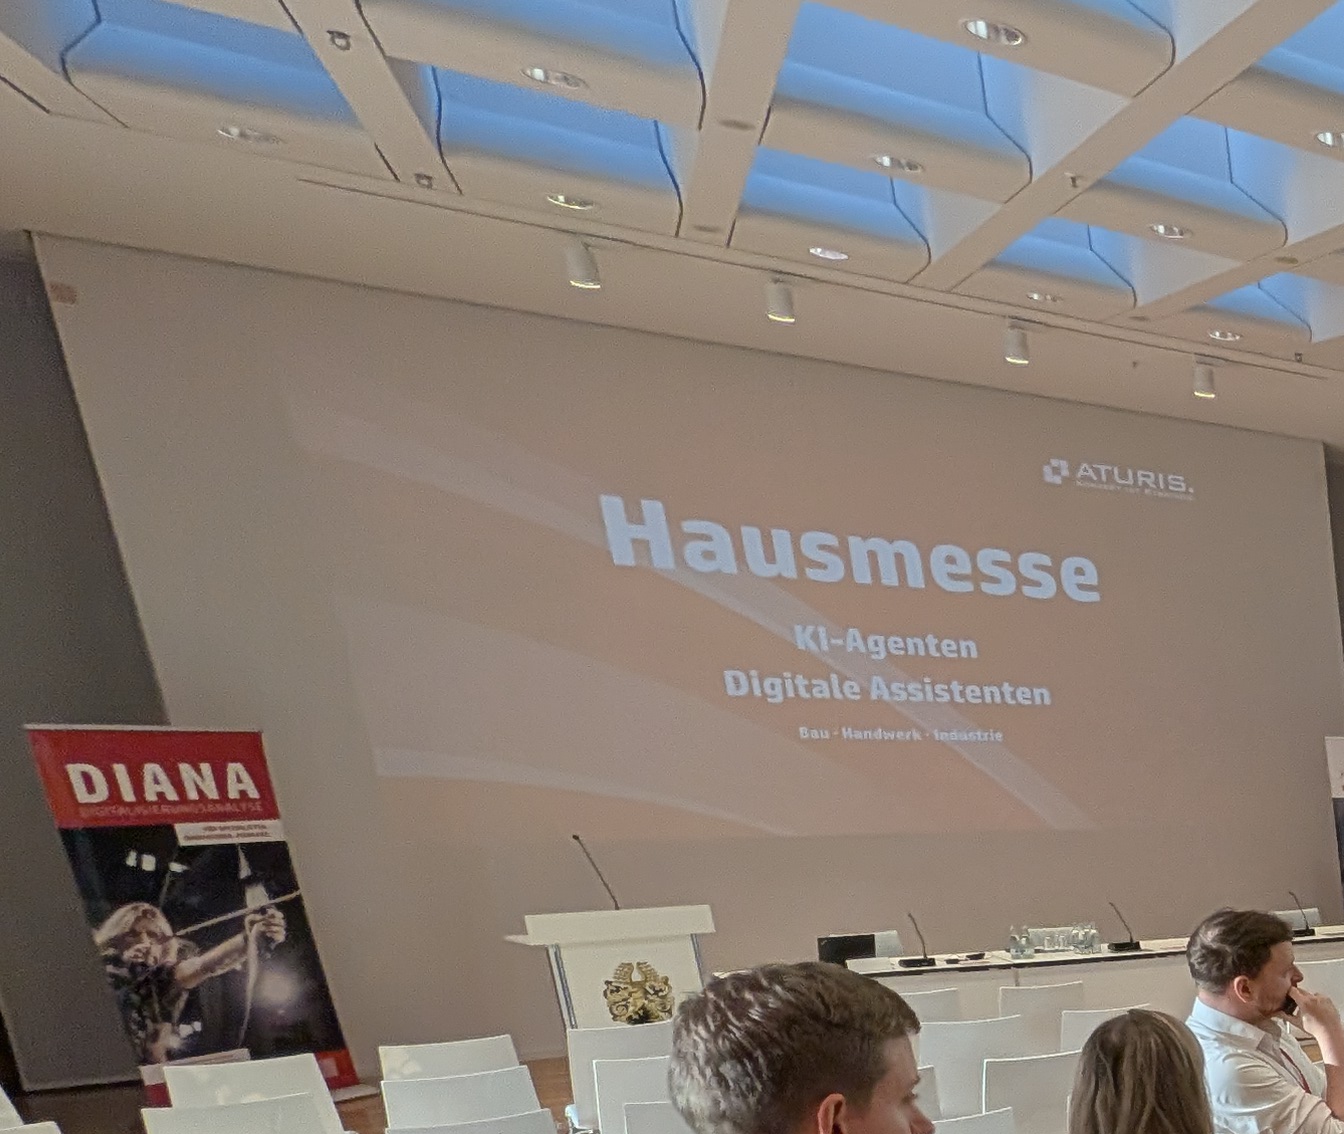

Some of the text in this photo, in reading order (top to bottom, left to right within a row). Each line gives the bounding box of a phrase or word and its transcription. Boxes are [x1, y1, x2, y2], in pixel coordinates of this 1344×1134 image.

[599, 494, 1101, 602] Hausmesse
[794, 624, 978, 660] KI-Agenten
[722, 668, 1052, 705] Digitale Assistenten
[799, 726, 1004, 743] Bau Handwerk Industrie
[65, 763, 260, 803] DIANA
